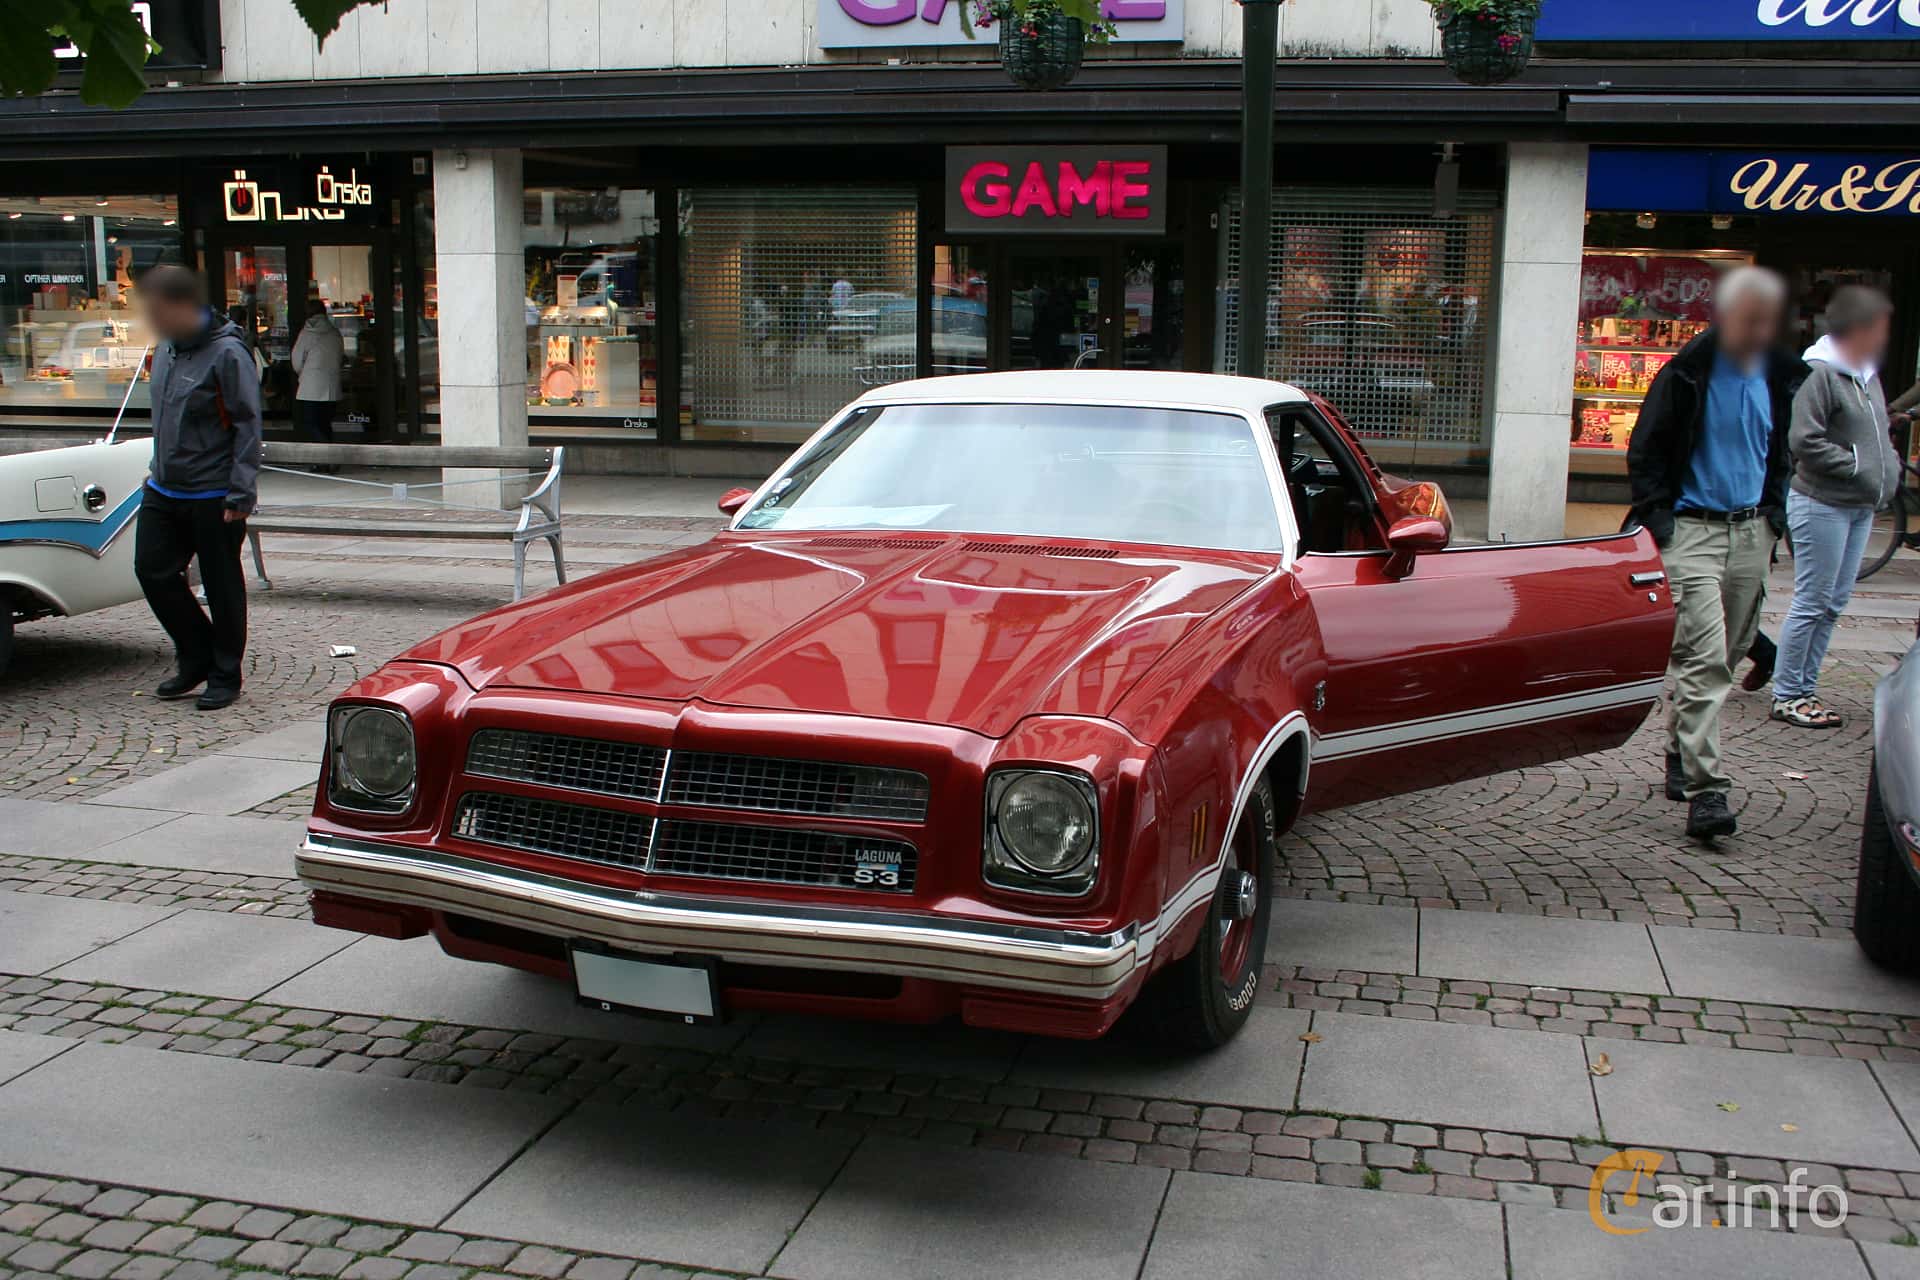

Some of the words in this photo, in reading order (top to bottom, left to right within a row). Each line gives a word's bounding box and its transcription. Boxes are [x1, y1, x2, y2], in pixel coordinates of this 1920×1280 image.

[317, 166, 372, 205] Önska
[960, 161, 1150, 219] GAME
[1603, 359, 1627, 369] REA
[624, 417, 648, 428] Önska
[855, 849, 902, 863] LAGUNA
